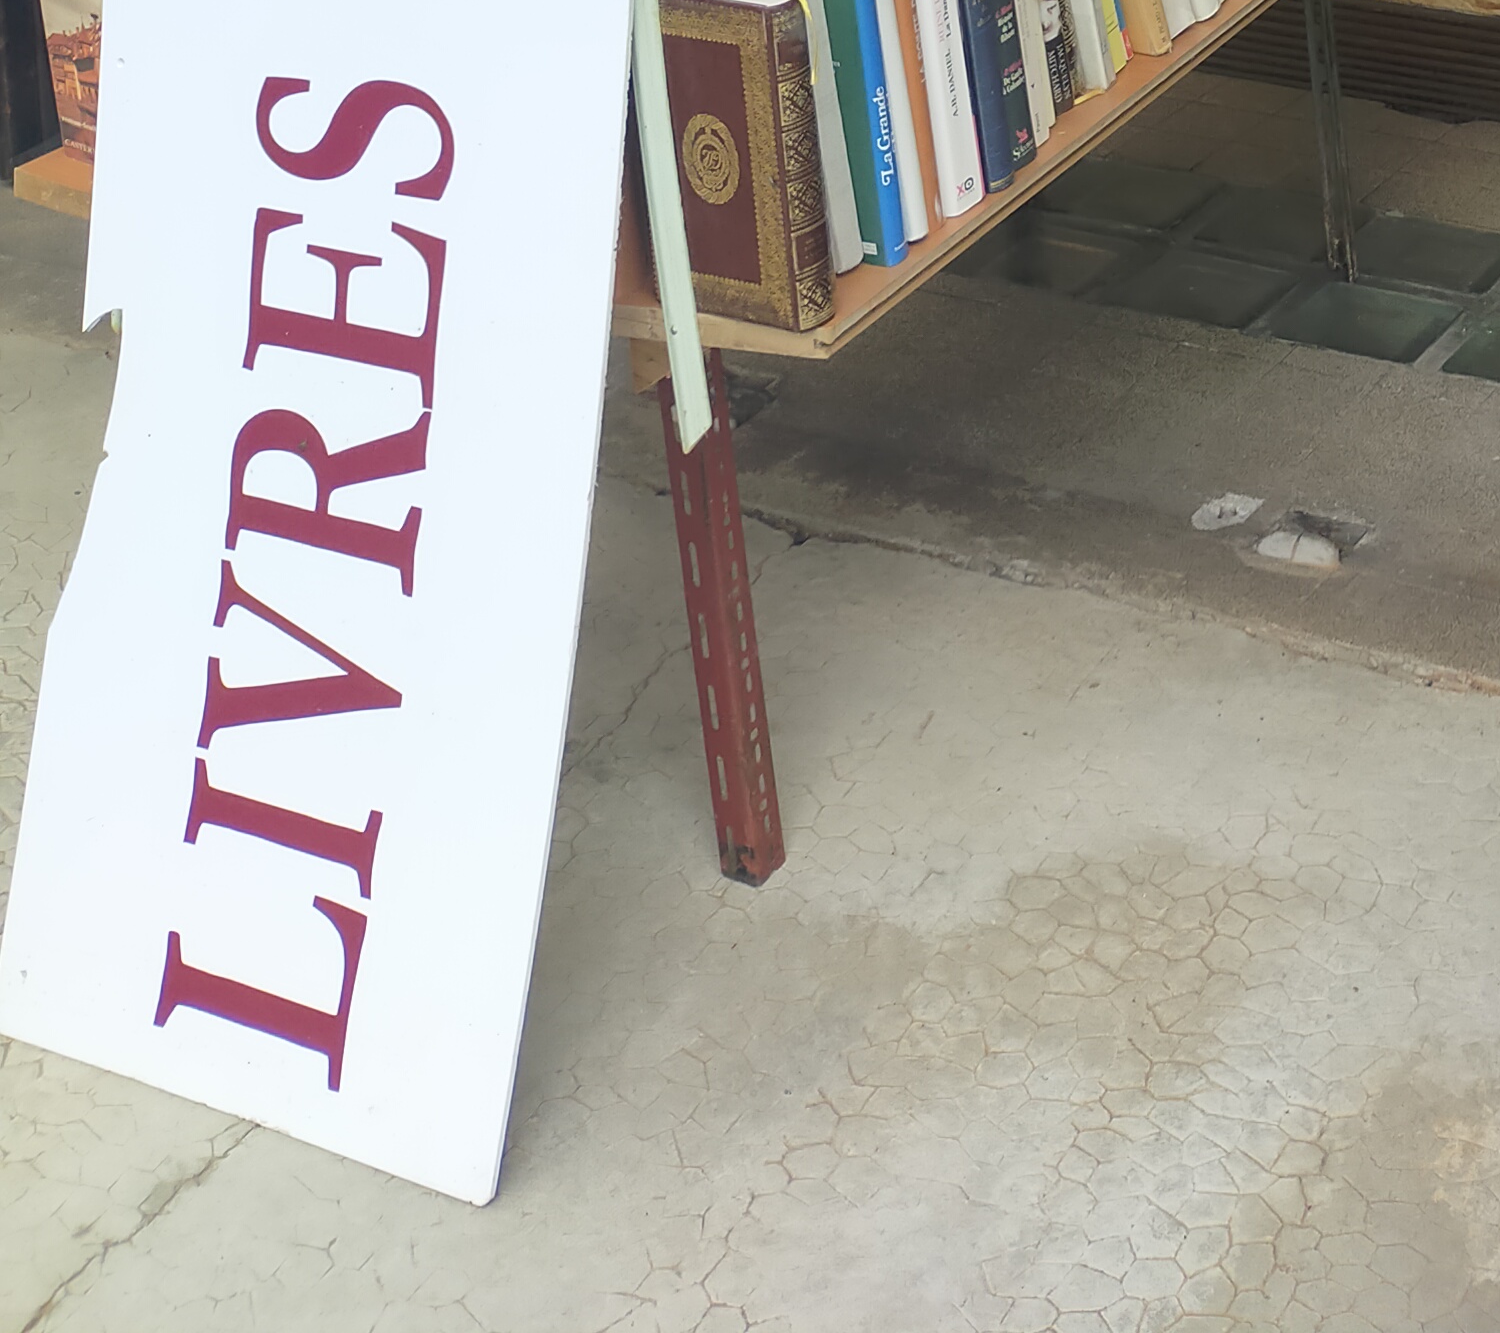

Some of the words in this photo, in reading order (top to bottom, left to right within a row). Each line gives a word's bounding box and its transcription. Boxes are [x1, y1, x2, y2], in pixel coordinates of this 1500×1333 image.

[934, 7, 945, 42] REINE
[945, 47, 956, 93] DANIEL
[1046, 49, 1064, 103] MITCHARD
[872, 84, 892, 151] Grande
[880, 151, 895, 186] La
[161, 78, 453, 1085] LIVRES
